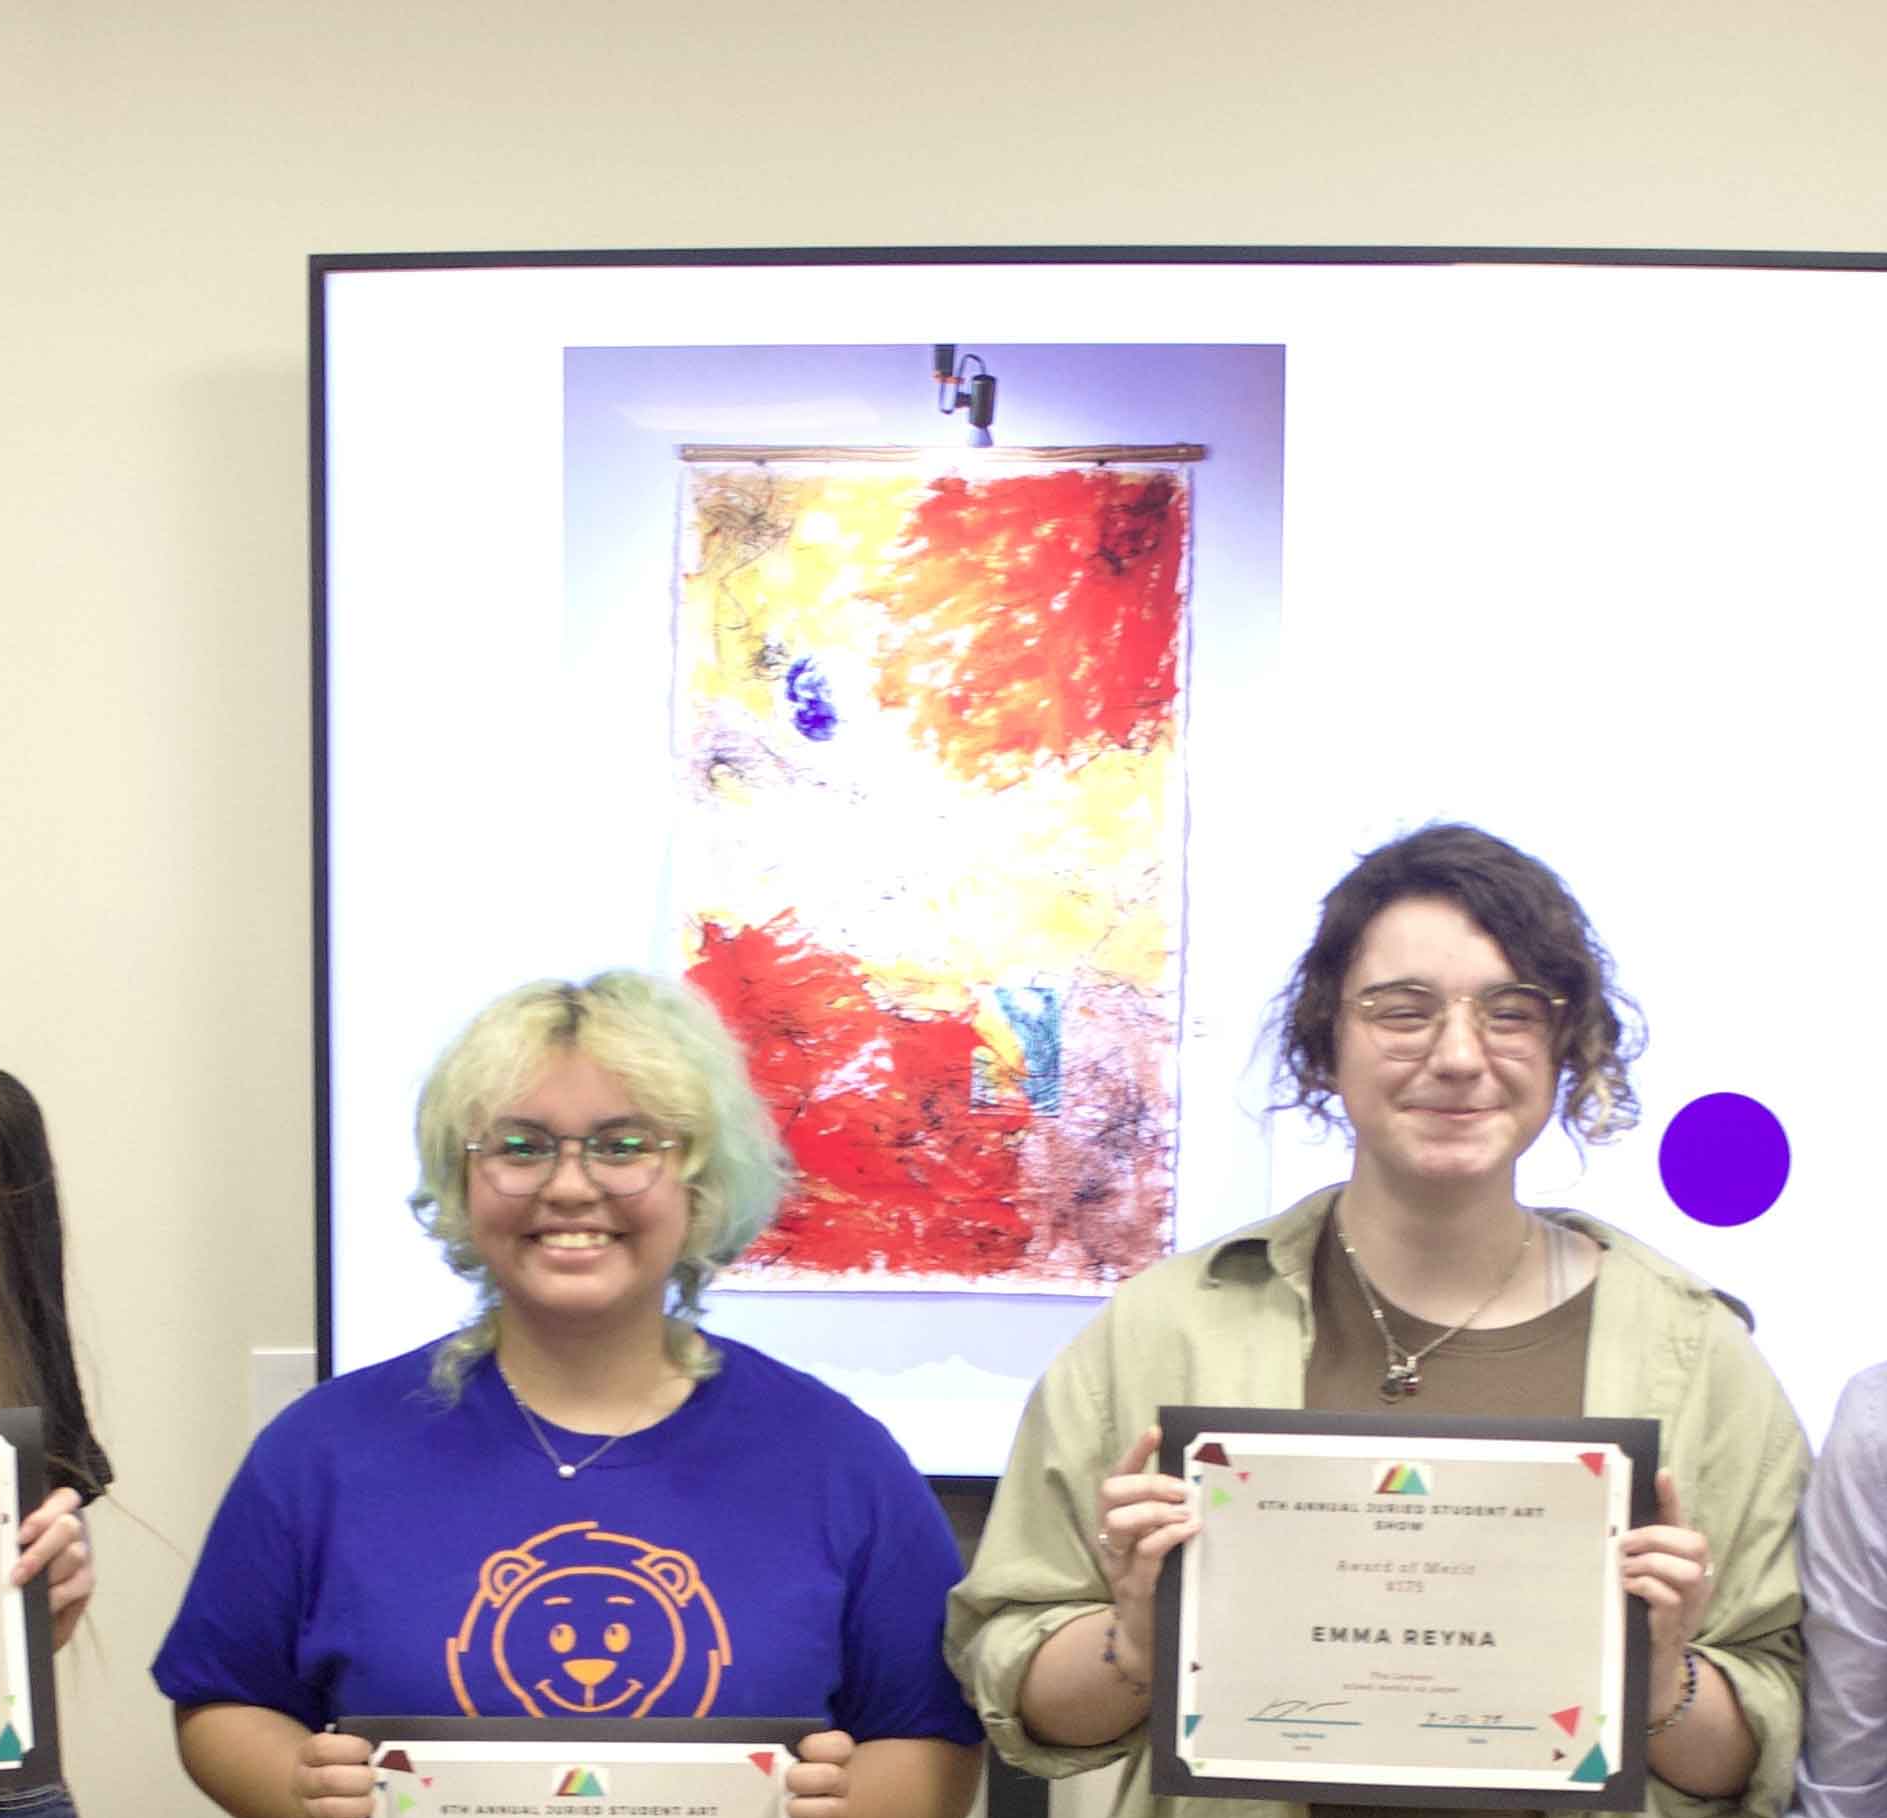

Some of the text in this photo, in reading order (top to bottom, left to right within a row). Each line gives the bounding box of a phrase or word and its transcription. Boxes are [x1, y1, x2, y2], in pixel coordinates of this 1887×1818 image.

[1293, 1502, 1359, 1513] ANNUAL
[1365, 1503, 1426, 1515] JURIED
[1431, 1504, 1507, 1516] STUDENT
[1511, 1506, 1545, 1517] ART
[1374, 1520, 1424, 1531] SHOW
[1336, 1560, 1476, 1575] Award of Merit
[1312, 1626, 1496, 1647] EMMA REYNA
[475, 1805, 540, 1816] ANNUAL
[545, 1805, 603, 1816] JURIED
[608, 1805, 682, 1817] STUDENT
[685, 1806, 719, 1817] ART
